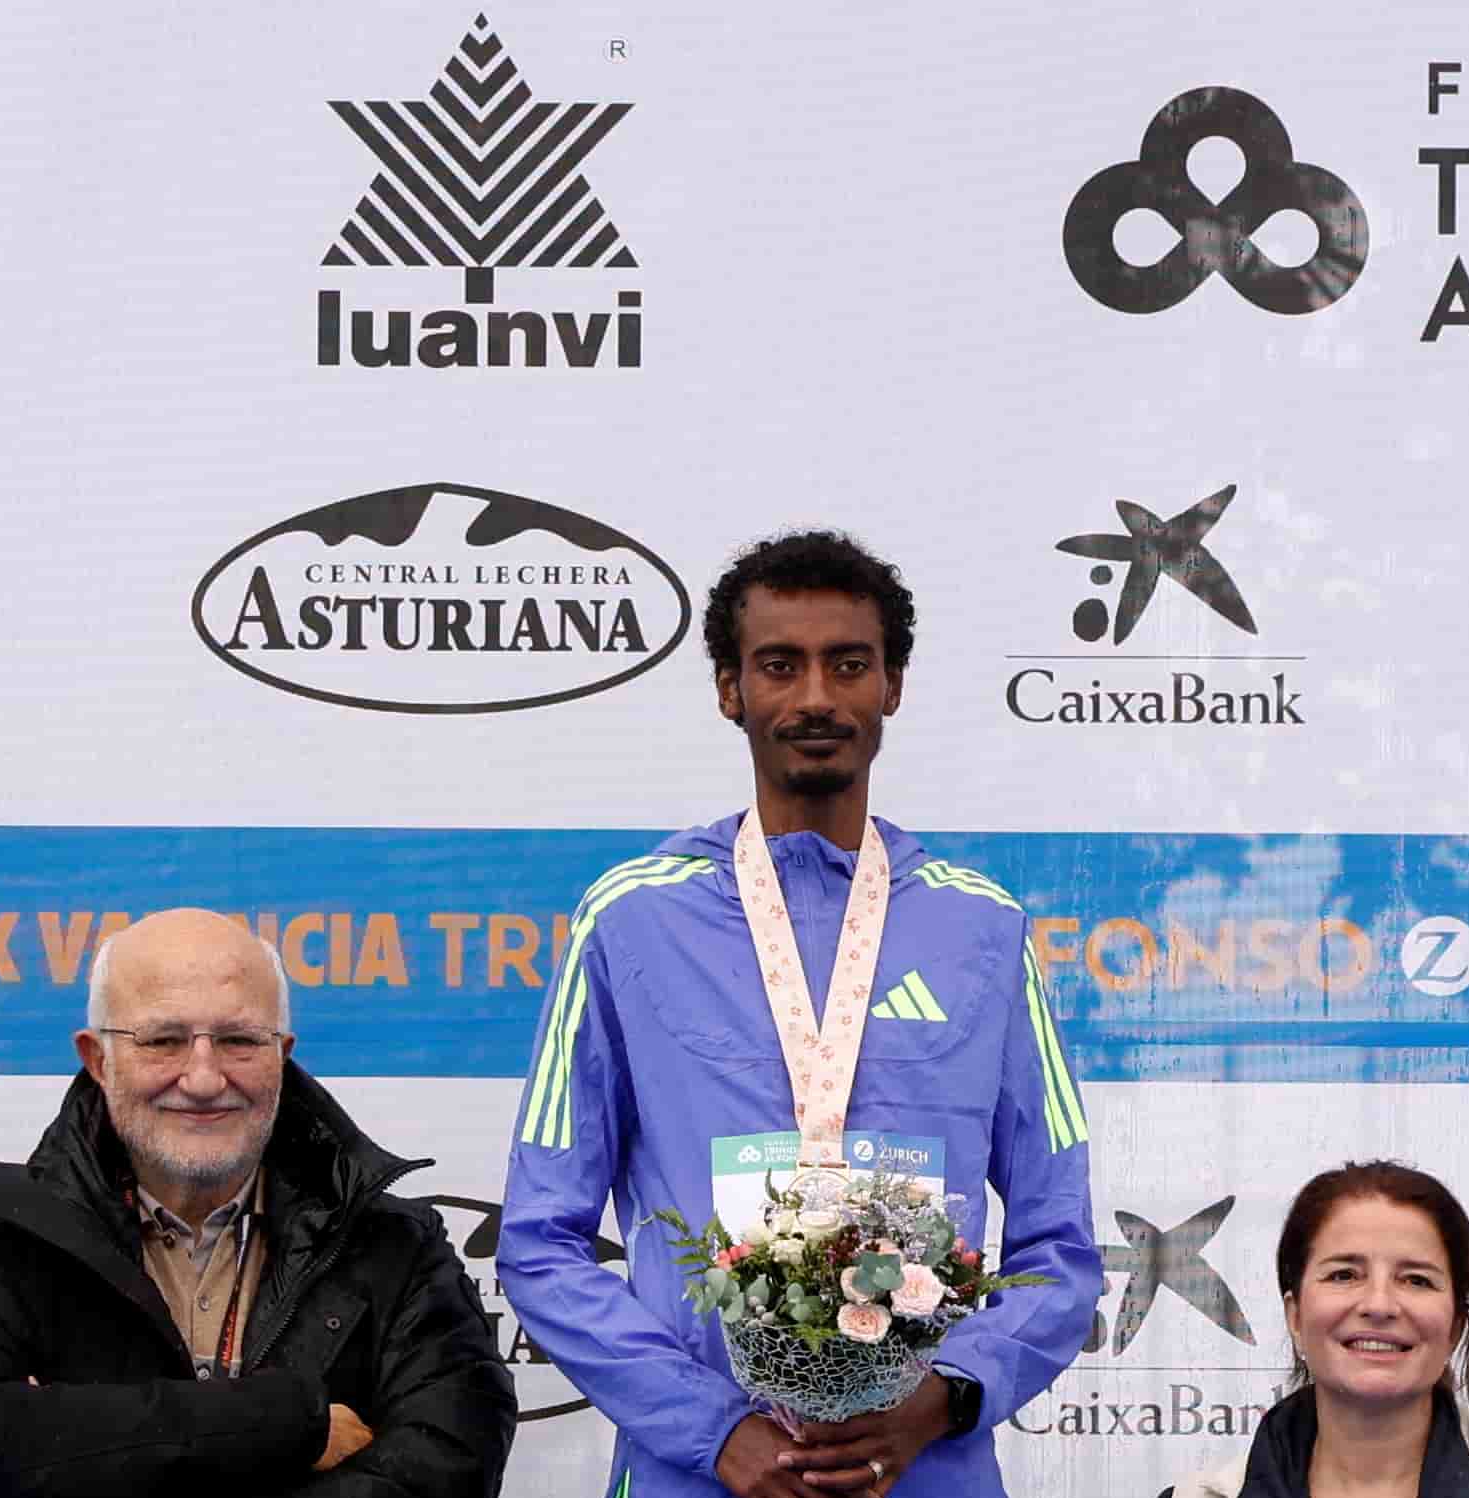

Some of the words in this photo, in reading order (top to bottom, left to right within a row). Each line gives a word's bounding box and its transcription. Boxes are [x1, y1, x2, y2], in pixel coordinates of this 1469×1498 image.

[317, 290, 642, 368] luanvi
[305, 564, 452, 583] CENTRAL
[476, 566, 631, 584] LECHERA
[226, 566, 649, 652] ASTURIANA
[1006, 669, 1304, 724] CaixaBank
[1010, 1384, 1288, 1436] CaixaBan
